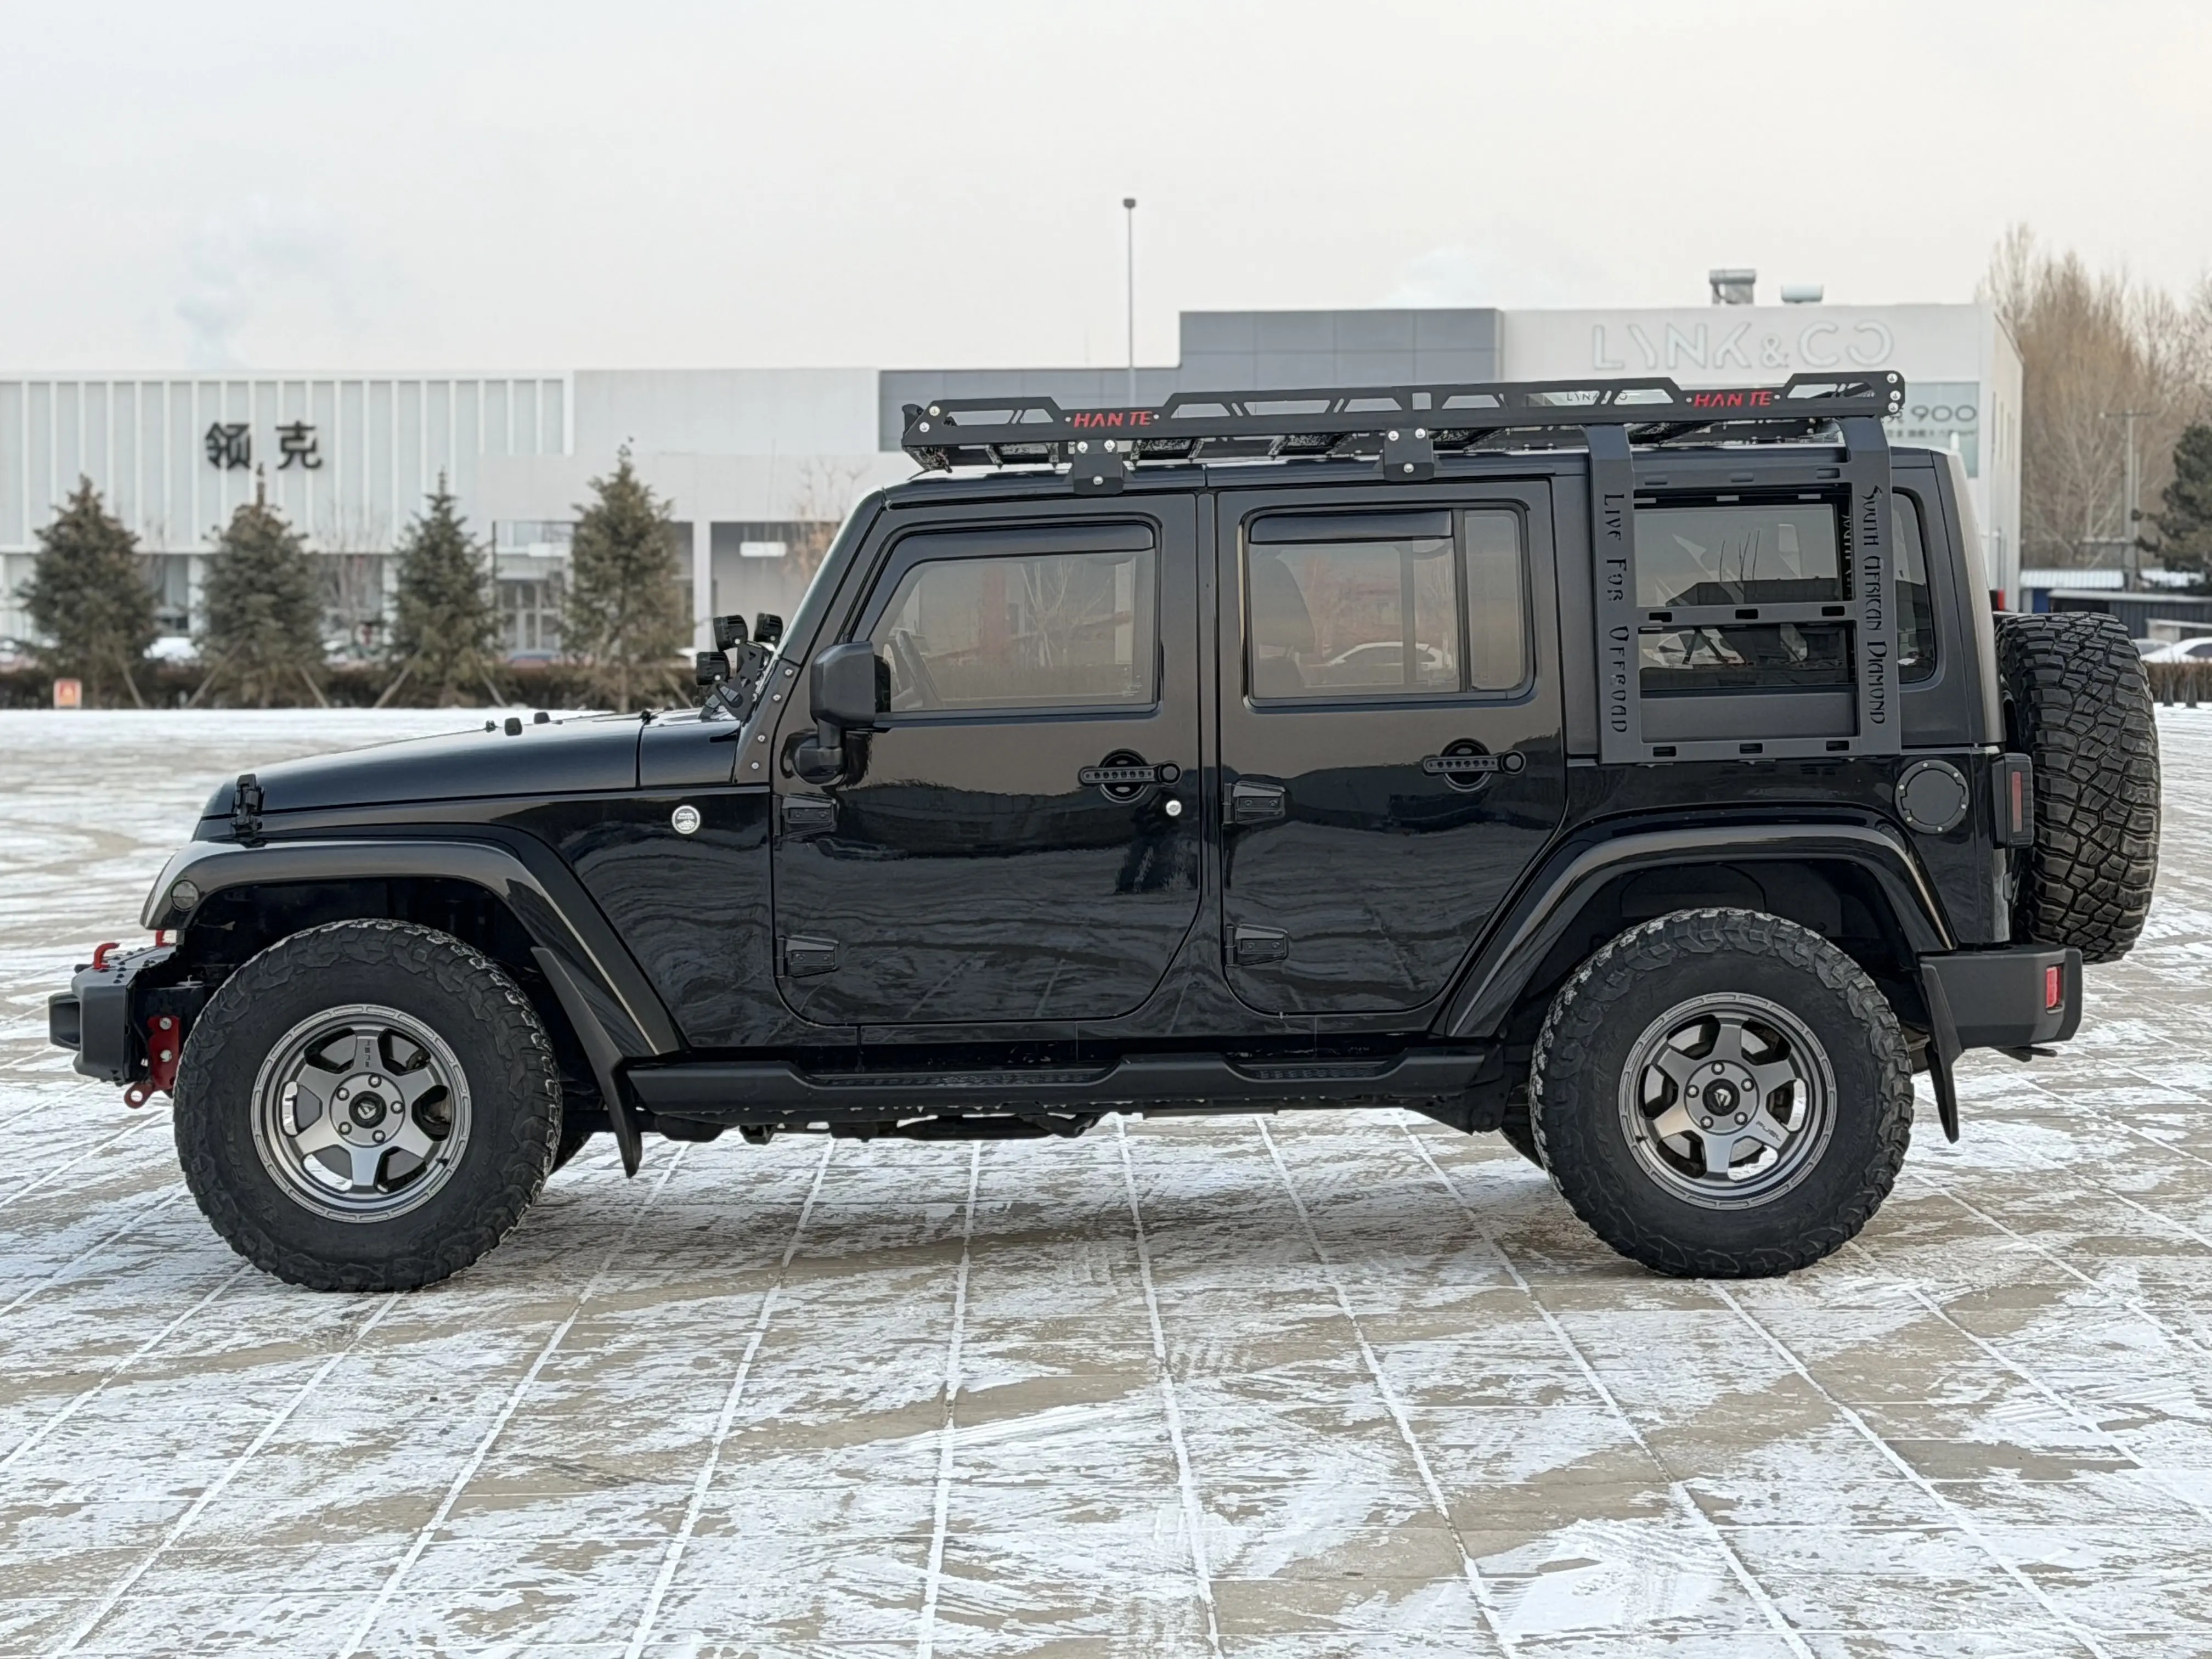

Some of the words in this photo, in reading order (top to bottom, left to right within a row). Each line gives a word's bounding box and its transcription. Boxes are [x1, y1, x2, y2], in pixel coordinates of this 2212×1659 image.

[1693, 393, 1744, 408] HAN
[1073, 413, 1124, 428] HAN
[205, 421, 323, 470] 领克
